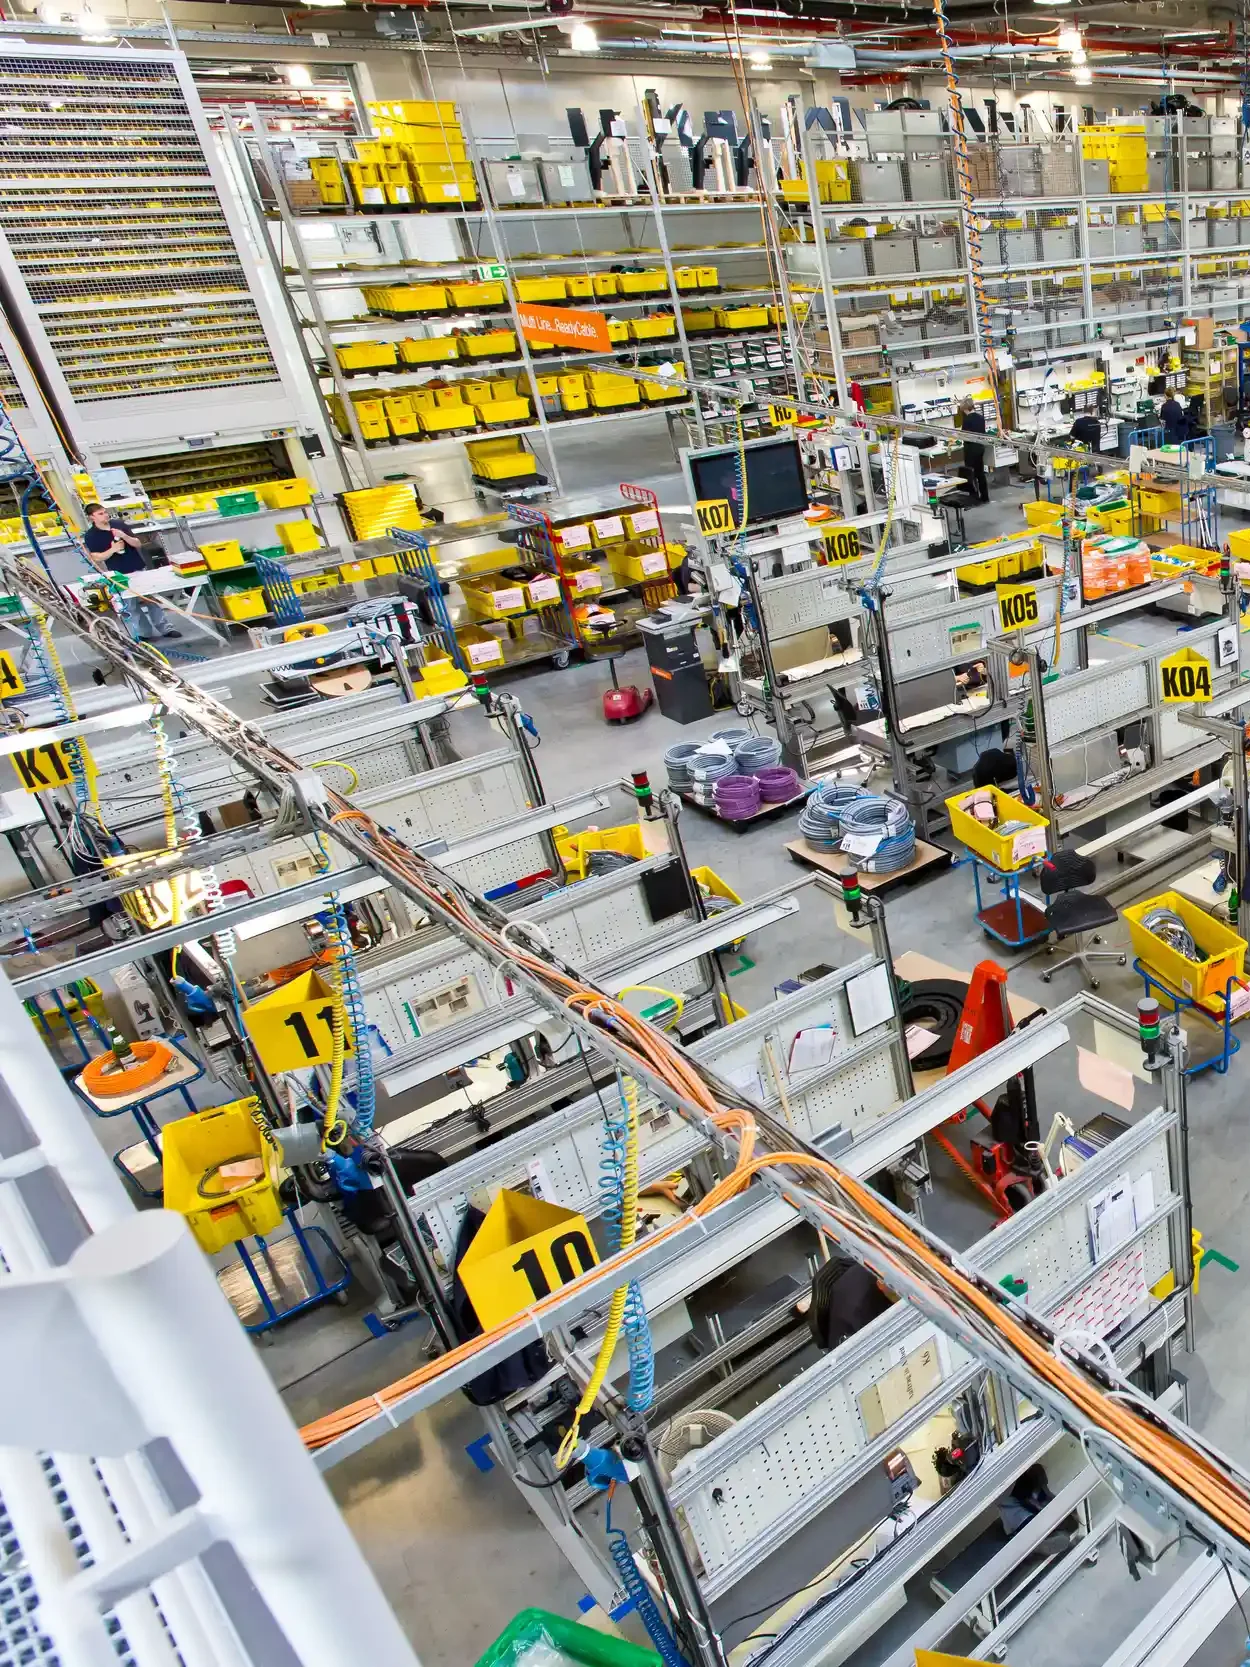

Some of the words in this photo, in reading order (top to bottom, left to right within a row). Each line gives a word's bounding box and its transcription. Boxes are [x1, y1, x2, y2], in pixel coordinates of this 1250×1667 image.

[519, 313, 536, 328] Multi
[696, 503, 729, 531] K07
[825, 531, 859, 562] K06
[1001, 591, 1039, 628] K05
[1162, 665, 1211, 697] K04
[512, 1230, 596, 1301] 10
